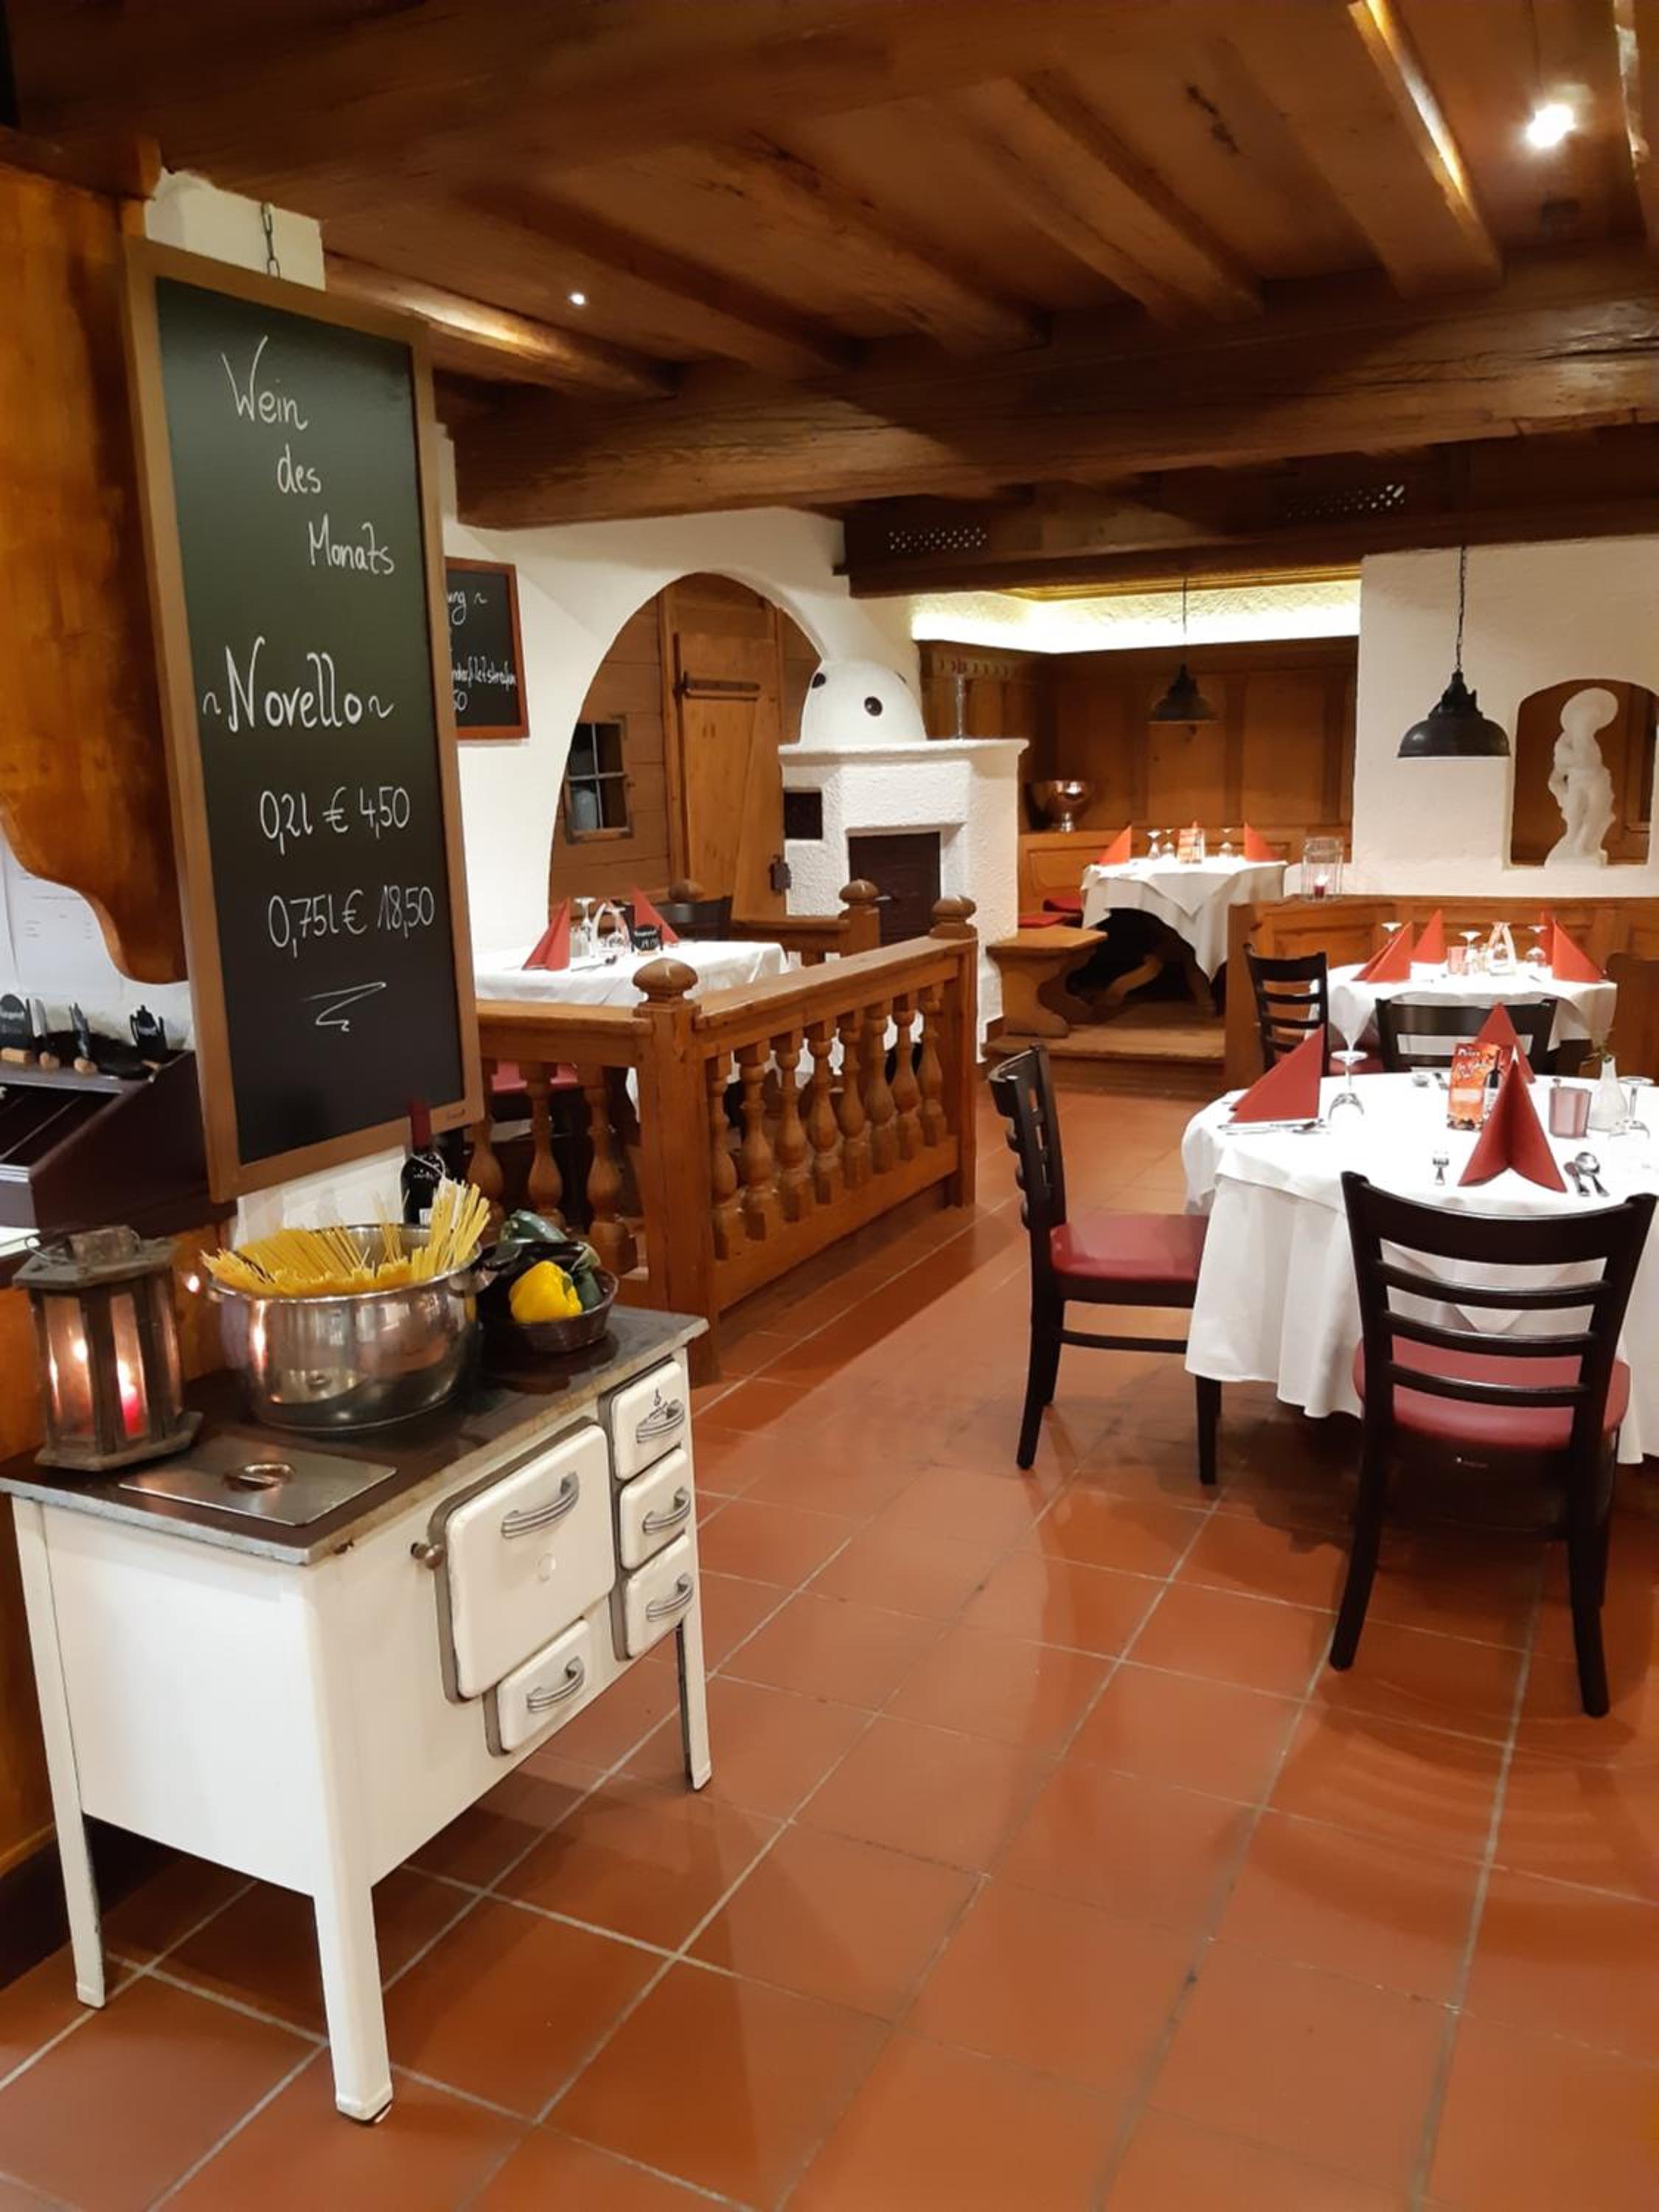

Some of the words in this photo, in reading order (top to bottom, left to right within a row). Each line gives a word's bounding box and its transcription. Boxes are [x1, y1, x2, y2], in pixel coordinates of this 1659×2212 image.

[222, 335, 308, 430] Wein
[276, 443, 321, 494] des
[308, 514, 394, 574] Monats
[225, 636, 364, 732] Novello
[322, 787, 349, 833] €
[360, 786, 411, 839] 4,50
[342, 889, 367, 935] €
[378, 885, 434, 938] 18,50
